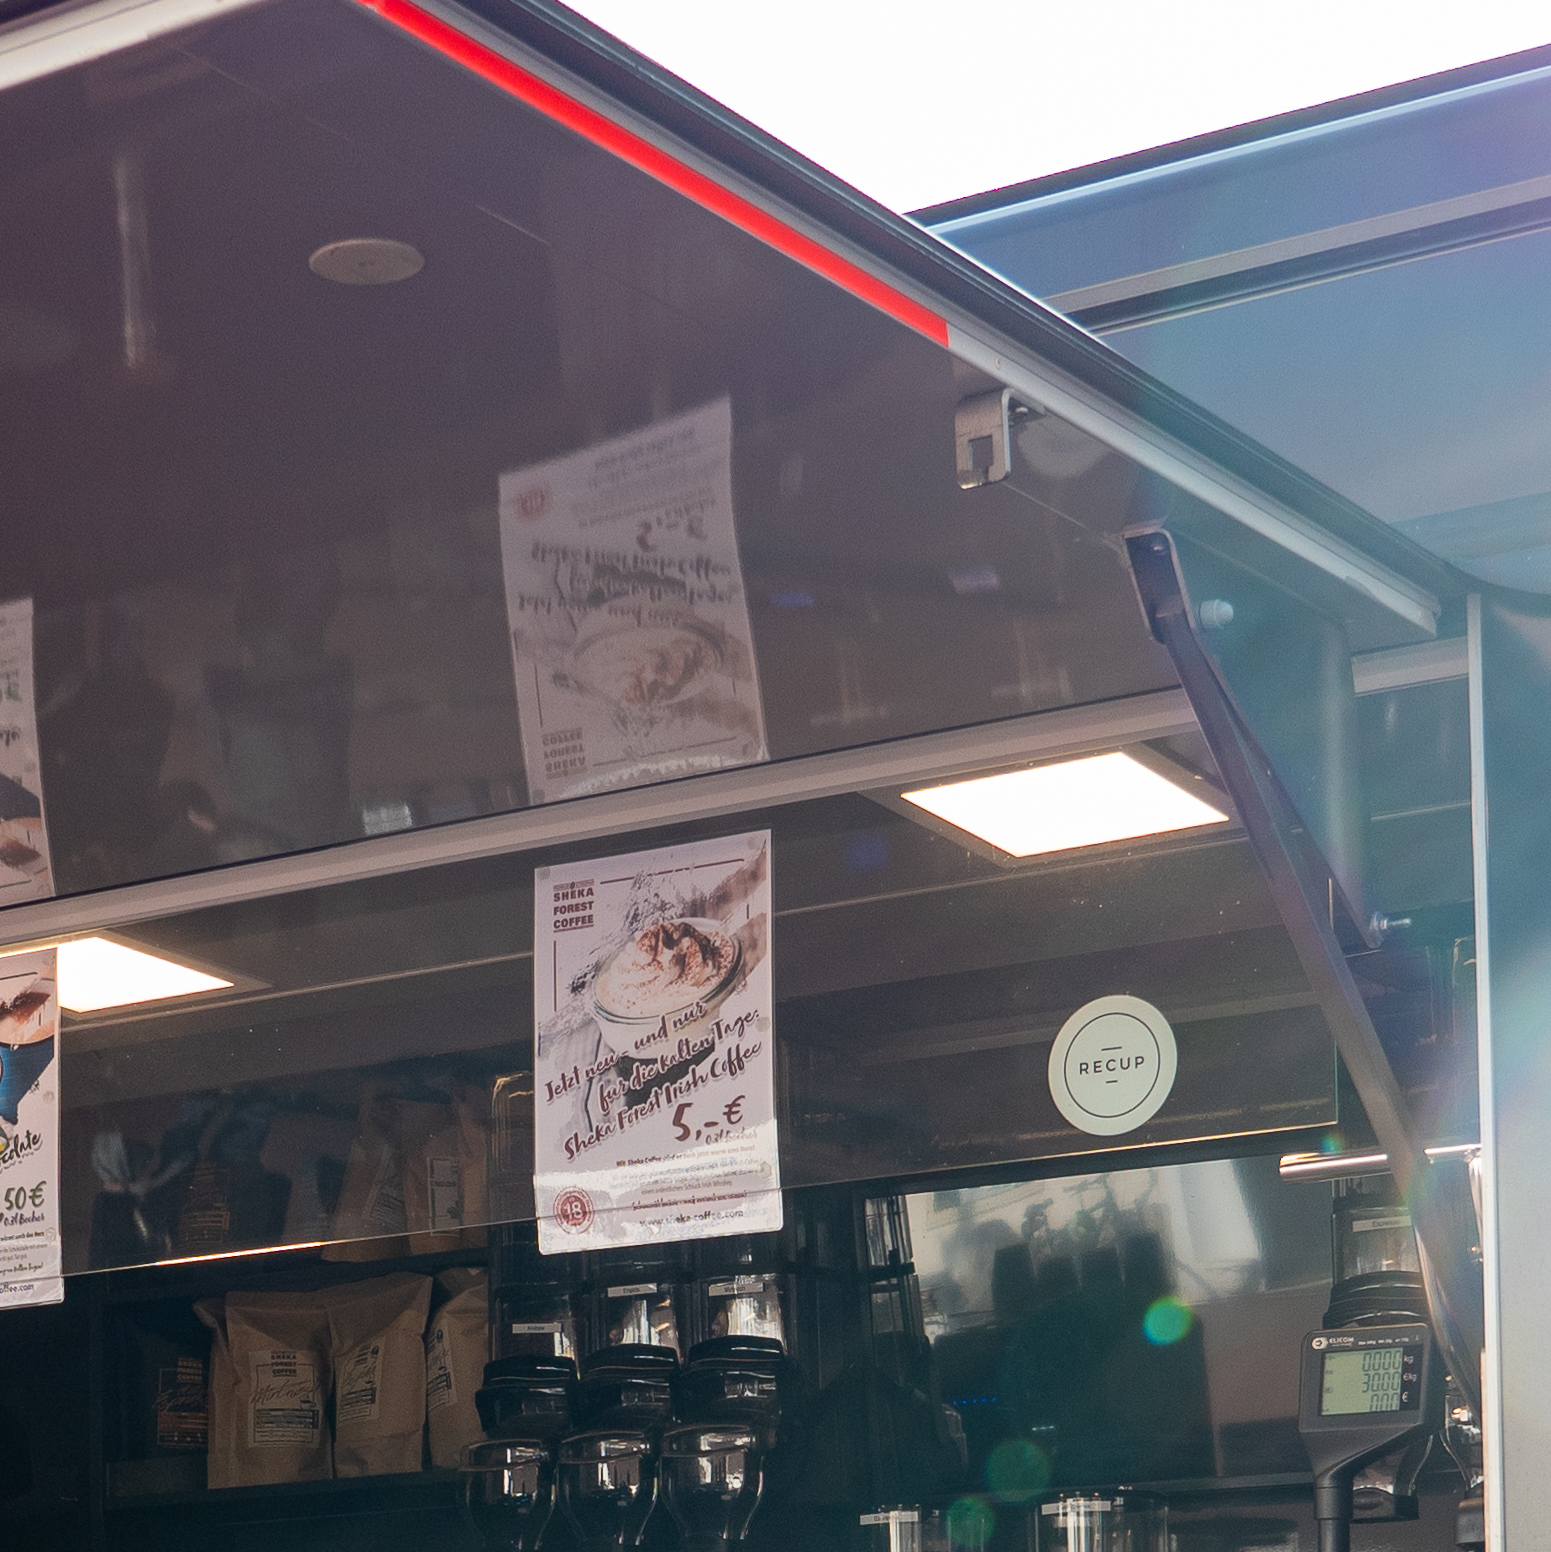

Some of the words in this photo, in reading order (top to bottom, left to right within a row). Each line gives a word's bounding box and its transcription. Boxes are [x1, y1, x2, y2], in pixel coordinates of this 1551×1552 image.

[553, 887, 594, 902] SHEKA
[553, 901, 594, 916] FOREST
[553, 914, 594, 929] COFFEE
[545, 1066, 581, 1102] Jetzt
[585, 1054, 620, 1079] neu
[634, 1015, 669, 1050] und
[672, 1001, 707, 1029] nur
[631, 1065, 659, 1090] die
[659, 1034, 716, 1073] kalten
[713, 1009, 760, 1041] Tage:
[1079, 1056, 1145, 1075] RECUP
[564, 1123, 617, 1160] Sheka
[617, 1092, 663, 1131] Forest
[664, 1067, 709, 1105] Irish
[709, 1041, 763, 1079] Coffee
[563, 1201, 584, 1219] 18
